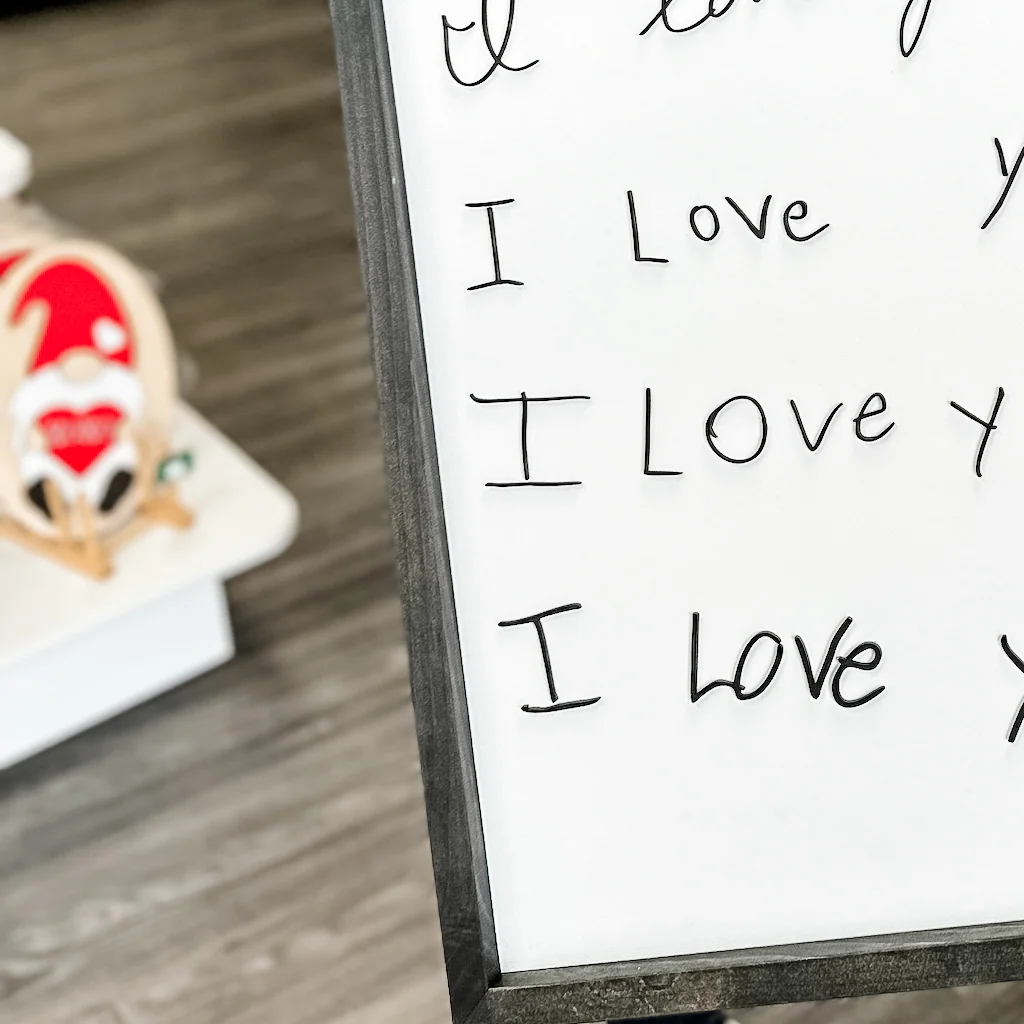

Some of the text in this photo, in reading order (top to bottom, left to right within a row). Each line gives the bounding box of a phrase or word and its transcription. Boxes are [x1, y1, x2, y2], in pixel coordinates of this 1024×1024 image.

[465, 198, 525, 291] I
[626, 190, 830, 264] Love
[469, 387, 591, 488] I
[497, 602, 602, 714] I
[690, 612, 886, 708] Love
